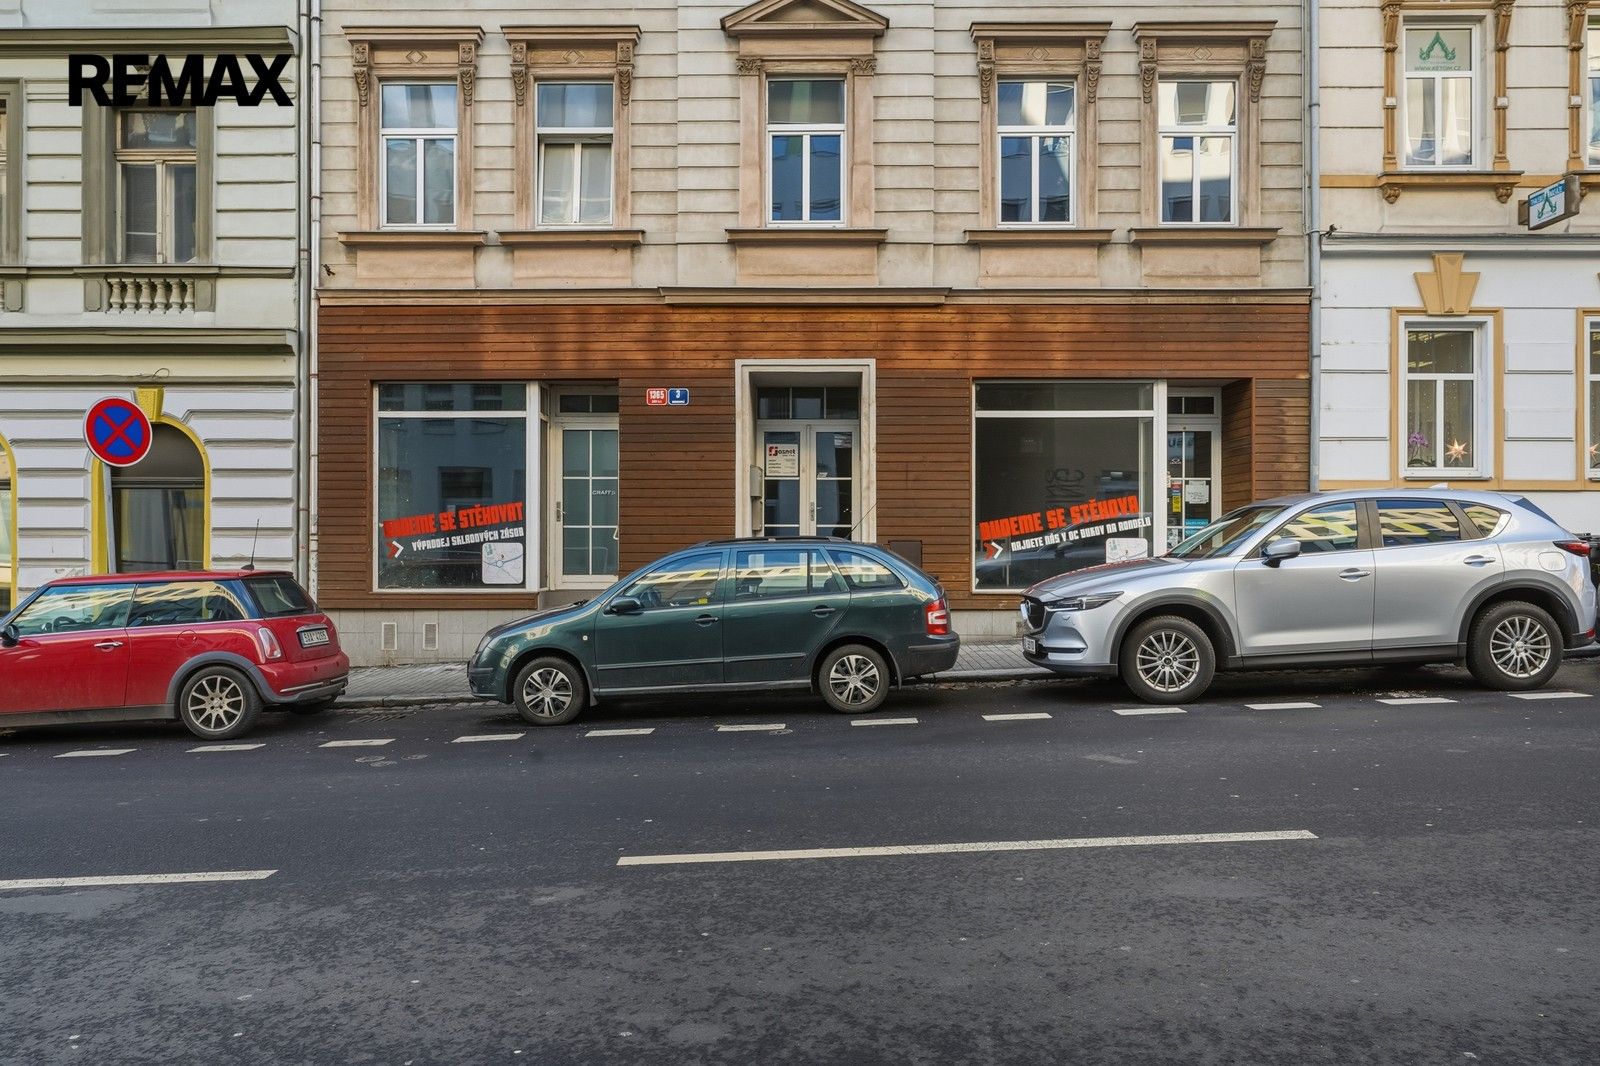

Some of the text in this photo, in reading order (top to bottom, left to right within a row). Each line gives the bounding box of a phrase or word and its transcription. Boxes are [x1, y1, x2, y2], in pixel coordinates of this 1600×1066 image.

[439, 510, 456, 531] SE
[1046, 508, 1065, 529] SE
[1045, 533, 1061, 546] NÁS
[1106, 523, 1118, 534] NA
